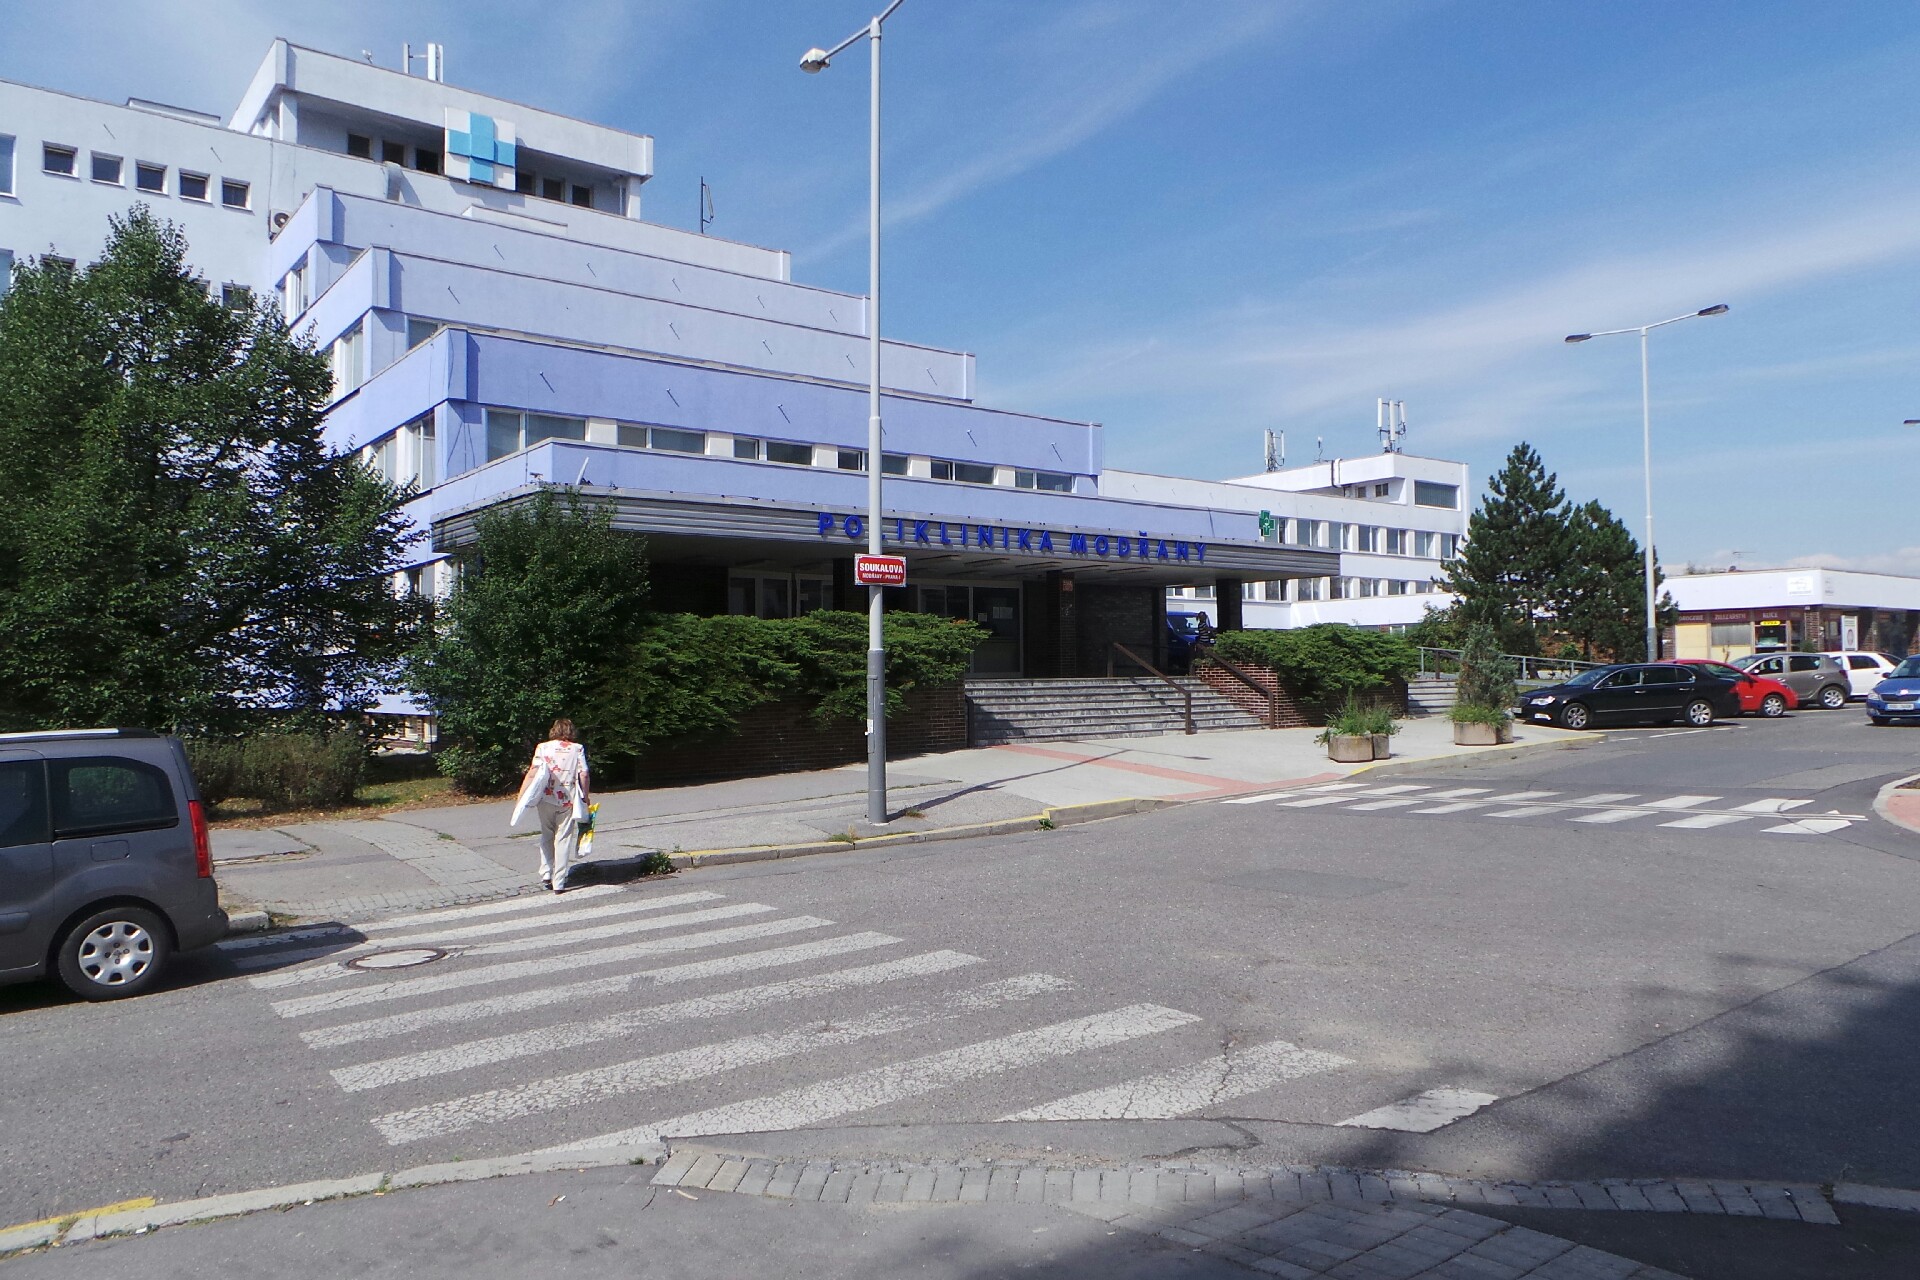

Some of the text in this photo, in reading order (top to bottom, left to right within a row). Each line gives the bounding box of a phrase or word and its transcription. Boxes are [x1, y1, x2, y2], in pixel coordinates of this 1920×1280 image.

[818, 512, 1206, 561] POIKLINIKA MODŘANY
[860, 563, 903, 573] SOUKALOVA
